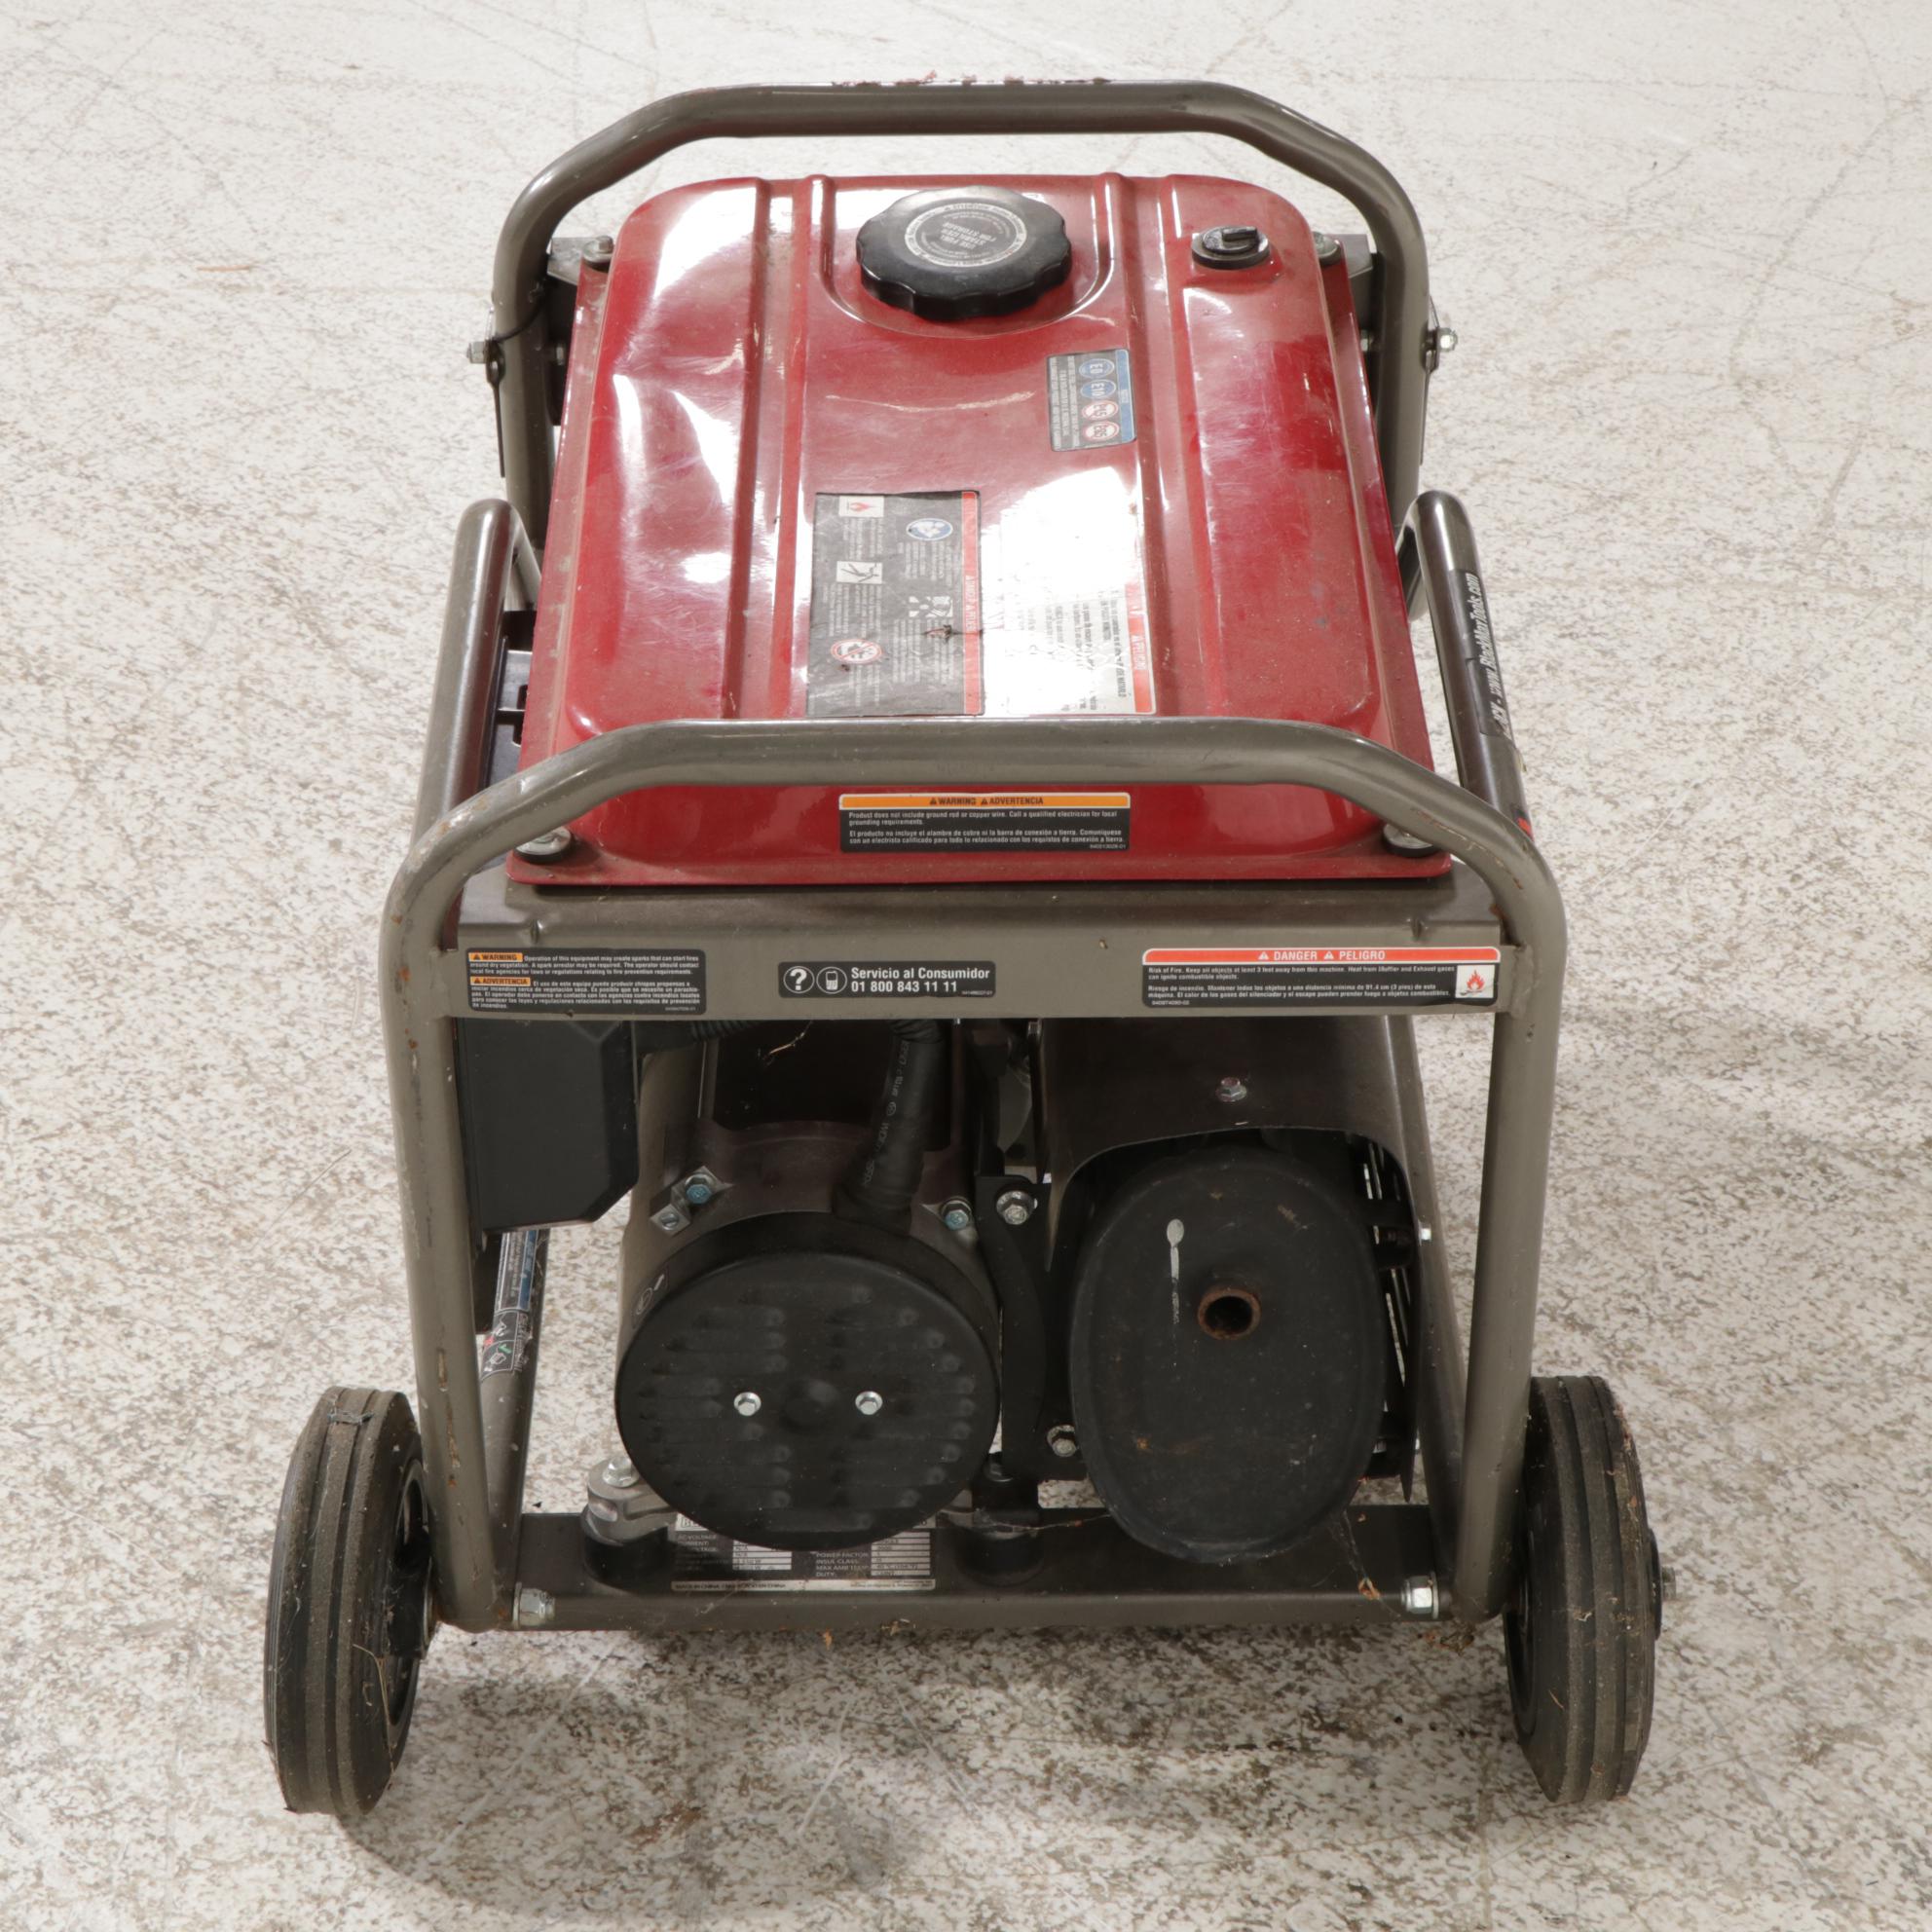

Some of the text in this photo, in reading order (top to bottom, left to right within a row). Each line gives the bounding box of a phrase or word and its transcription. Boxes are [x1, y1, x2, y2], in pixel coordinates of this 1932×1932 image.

[1091, 383, 1105, 396] E10
[1094, 426, 1107, 437] E85
[1274, 950, 1385, 960] DANGER PELIGRO
[851, 967, 989, 979] Servicio al Consumidor
[851, 981, 957, 992] 01 800 843 11 11
